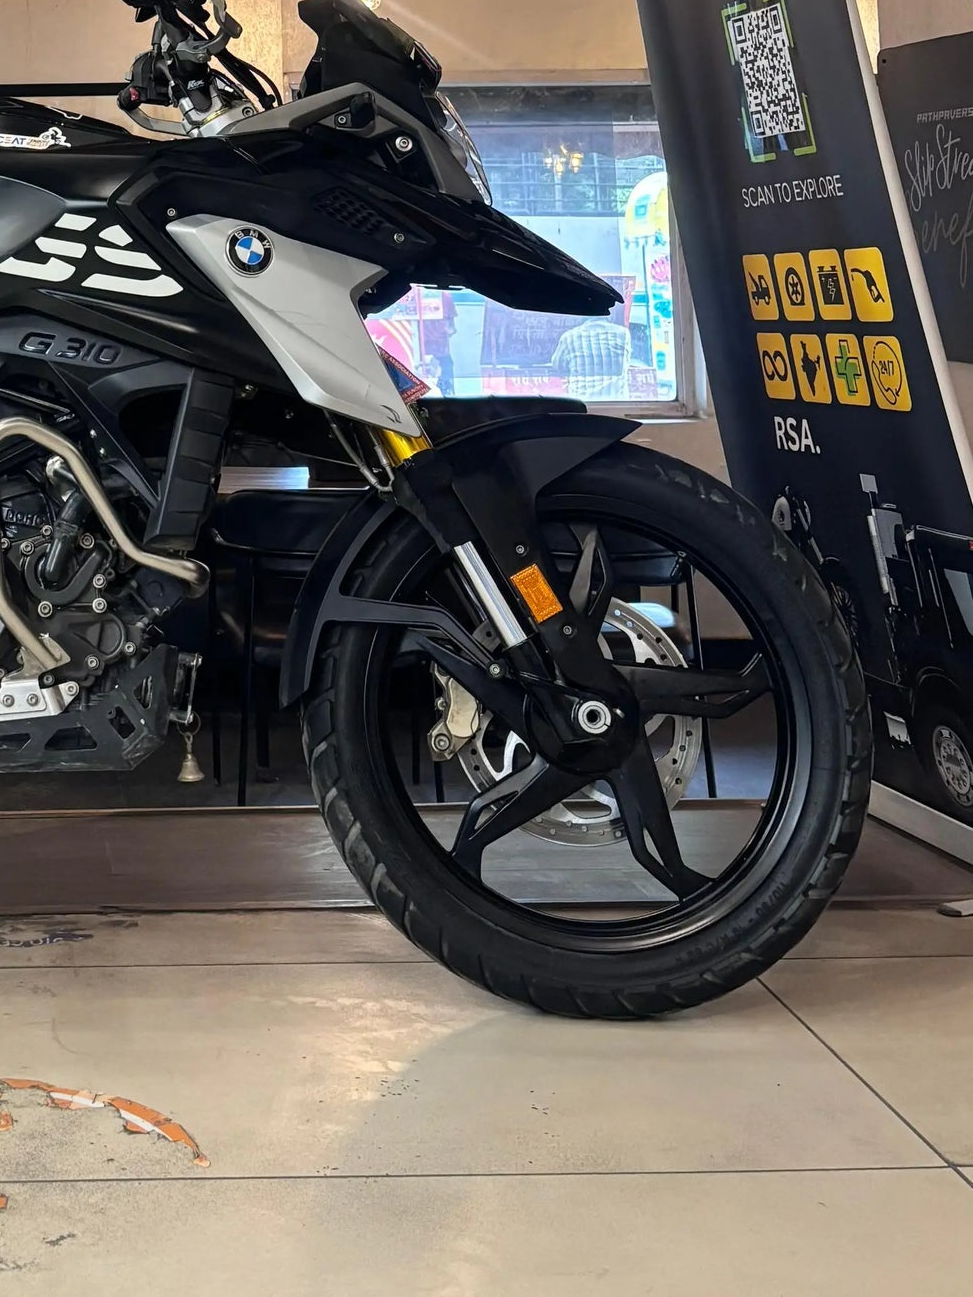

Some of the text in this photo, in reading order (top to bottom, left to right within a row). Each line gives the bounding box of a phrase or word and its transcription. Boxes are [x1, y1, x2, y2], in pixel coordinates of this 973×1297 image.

[742, 174, 845, 208] SCAN TO EXPLORE
[234, 228, 271, 250] BMW
[19, 331, 122, 365] G 310
[774, 415, 822, 456] RSA.
